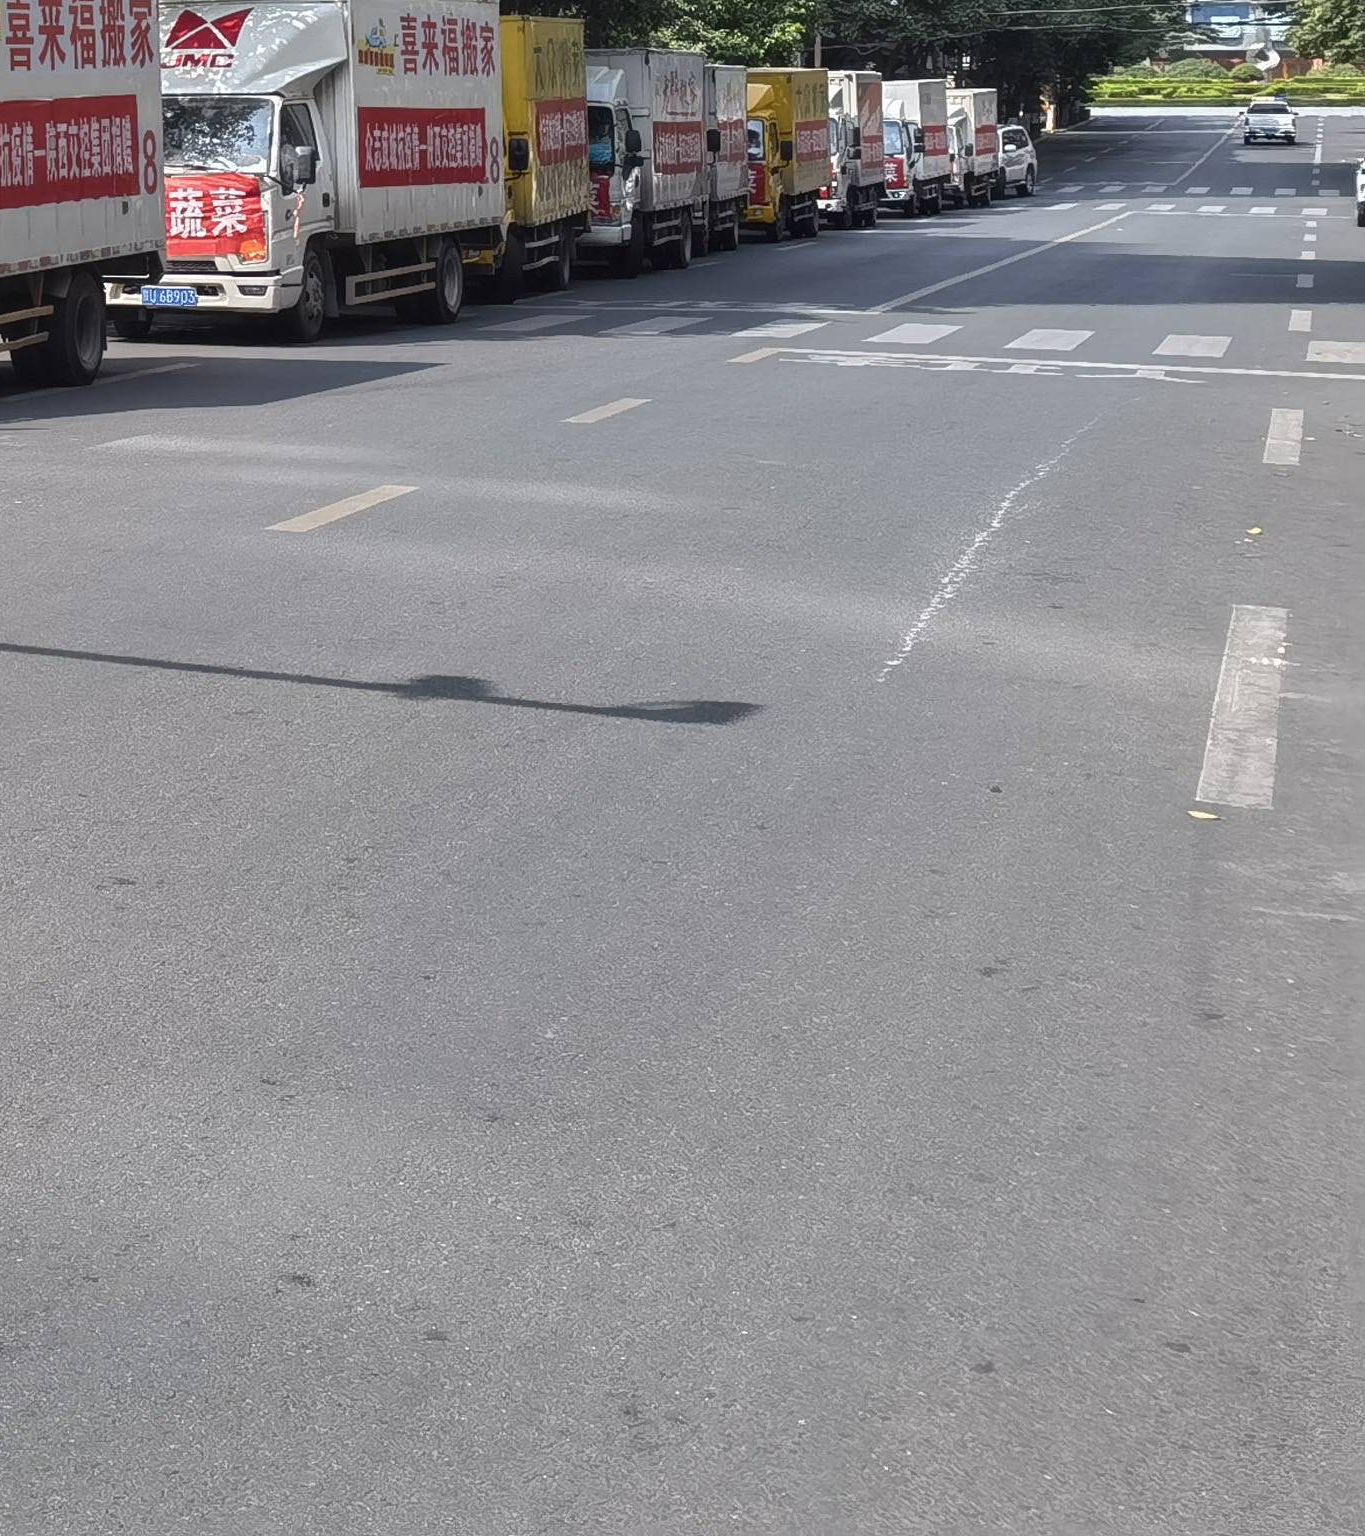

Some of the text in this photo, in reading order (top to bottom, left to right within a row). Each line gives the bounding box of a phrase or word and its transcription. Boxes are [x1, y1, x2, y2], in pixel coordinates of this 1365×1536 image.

[399, 13, 496, 78] 喜来福搬家
[169, 187, 248, 238] 蔬菜
